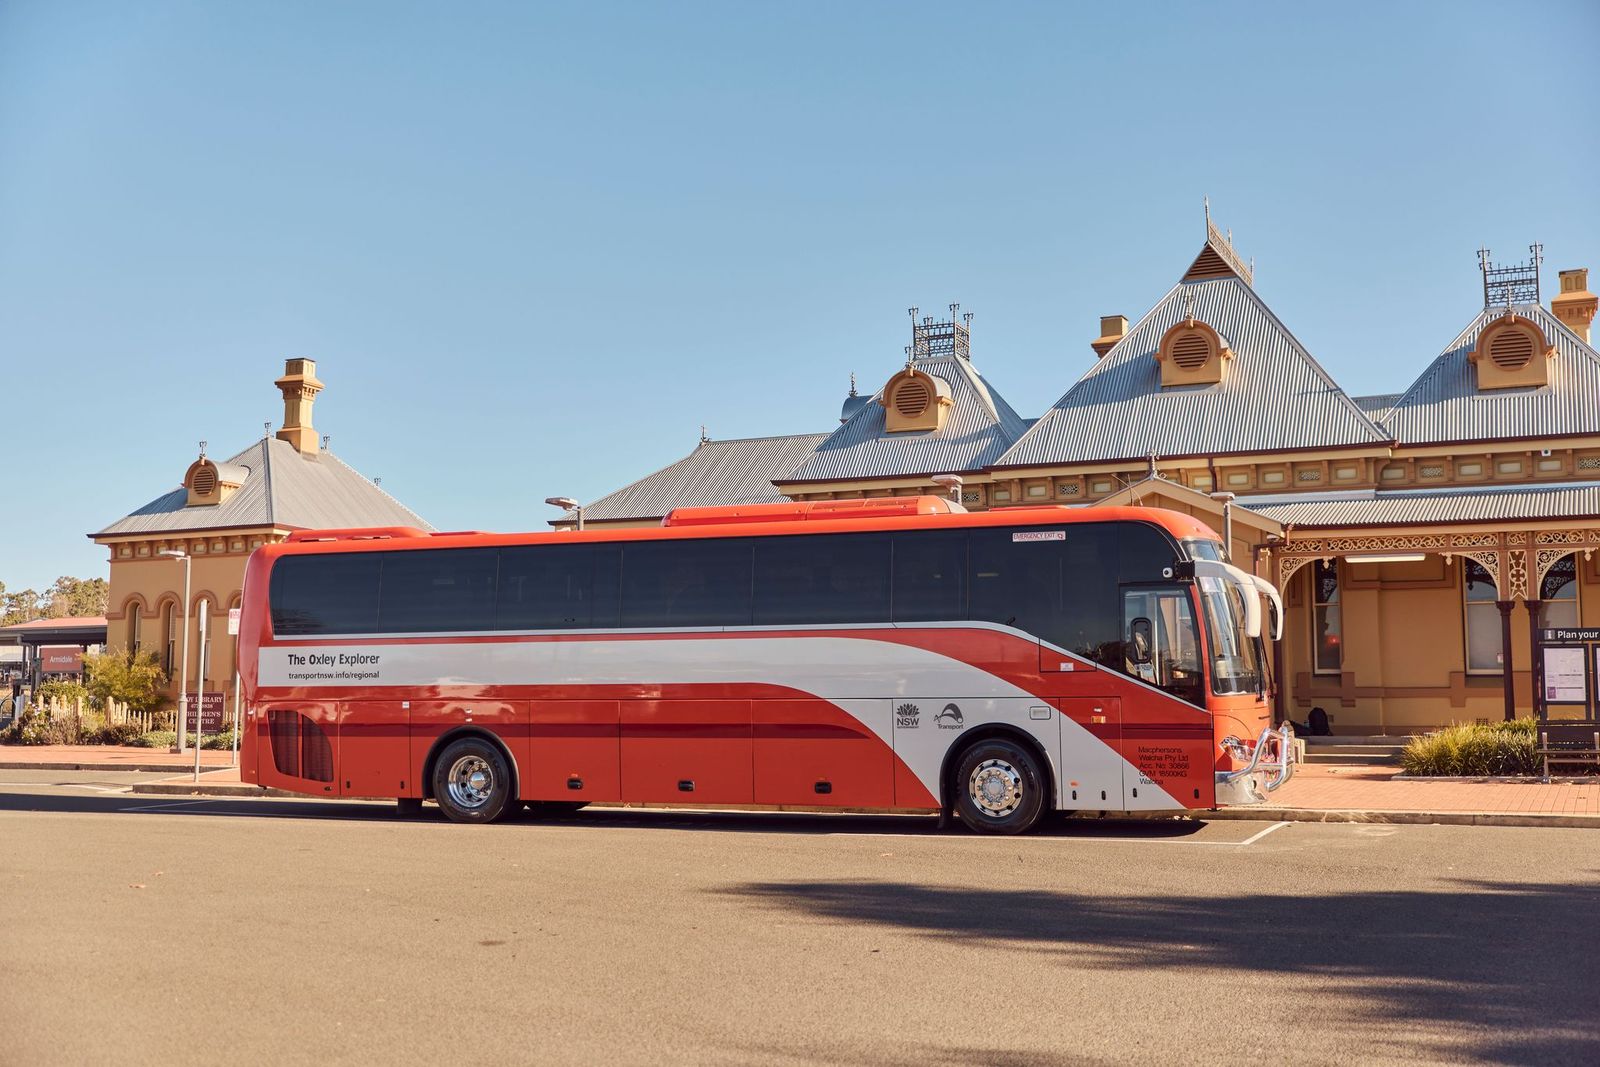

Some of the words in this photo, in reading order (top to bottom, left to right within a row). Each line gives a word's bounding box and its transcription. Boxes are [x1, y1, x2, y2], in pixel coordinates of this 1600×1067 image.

[1558, 630, 1577, 639] Plan
[1578, 632, 1598, 640] your
[288, 654, 306, 665] The
[309, 654, 336, 667] Oxley
[339, 653, 380, 667] Explorer
[288, 671, 380, 681] transportnsw.info/regional
[1138, 746, 1183, 754] Macphersons
